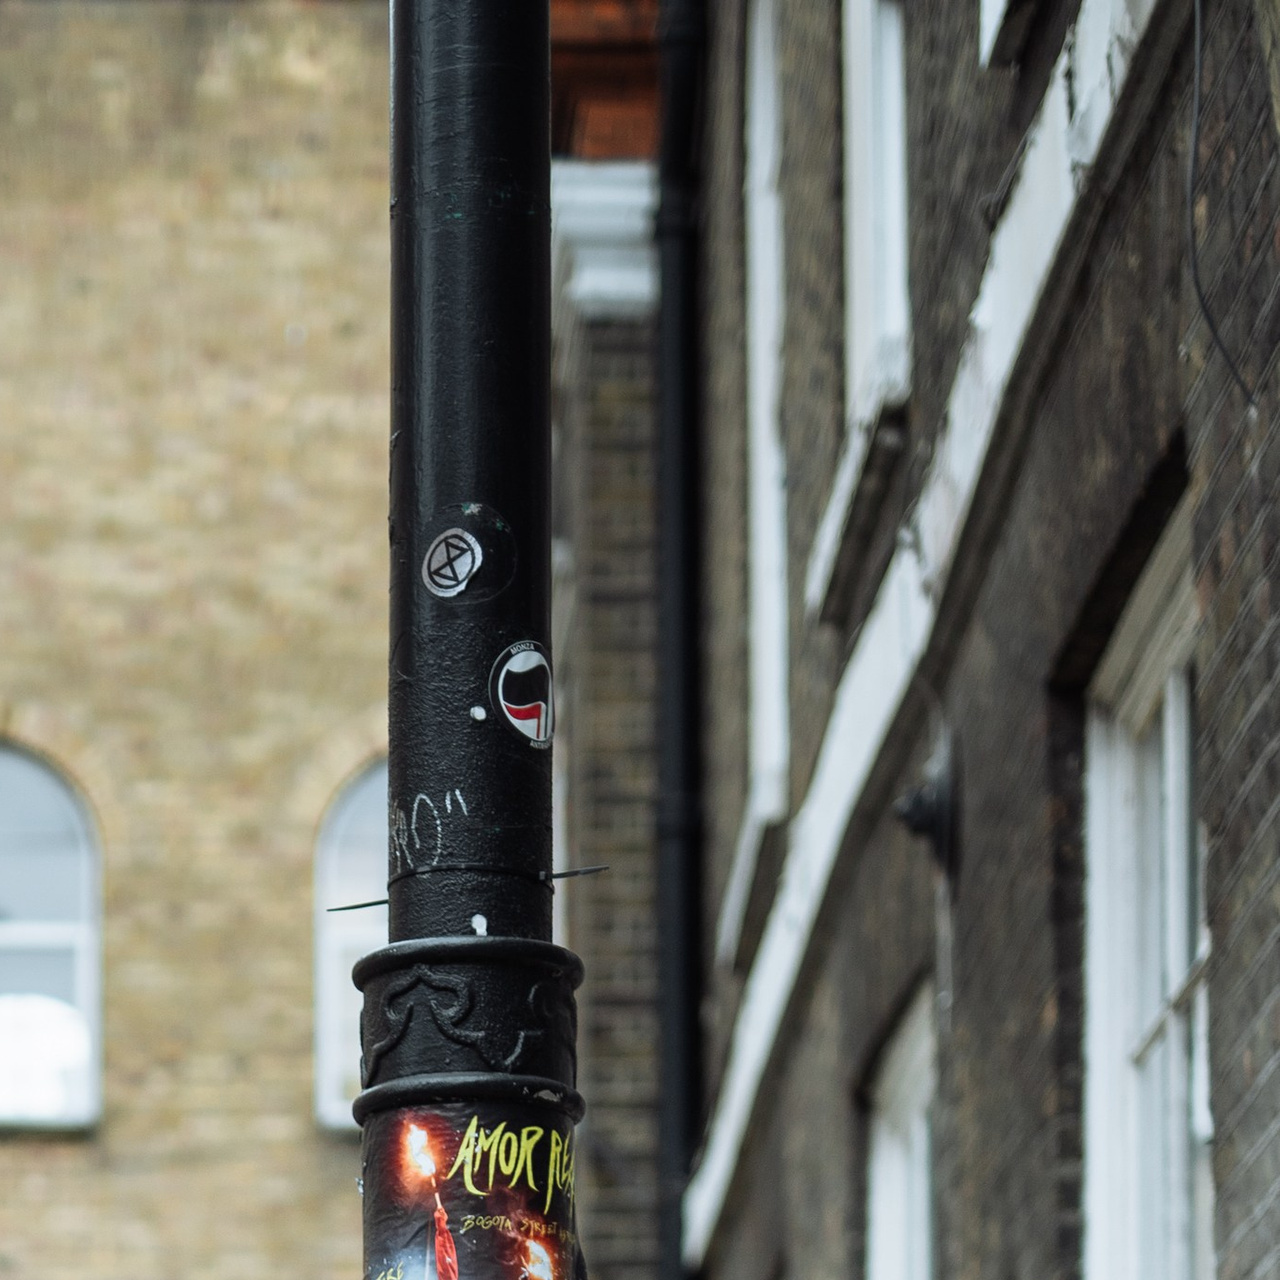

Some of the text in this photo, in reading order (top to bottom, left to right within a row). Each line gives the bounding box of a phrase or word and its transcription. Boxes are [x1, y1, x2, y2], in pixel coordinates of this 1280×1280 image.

[510, 643, 535, 655] MONZA
[446, 1114, 544, 1196] AMOR
[460, 1214, 512, 1234] BOGOTA
[520, 1217, 558, 1239] STREET
